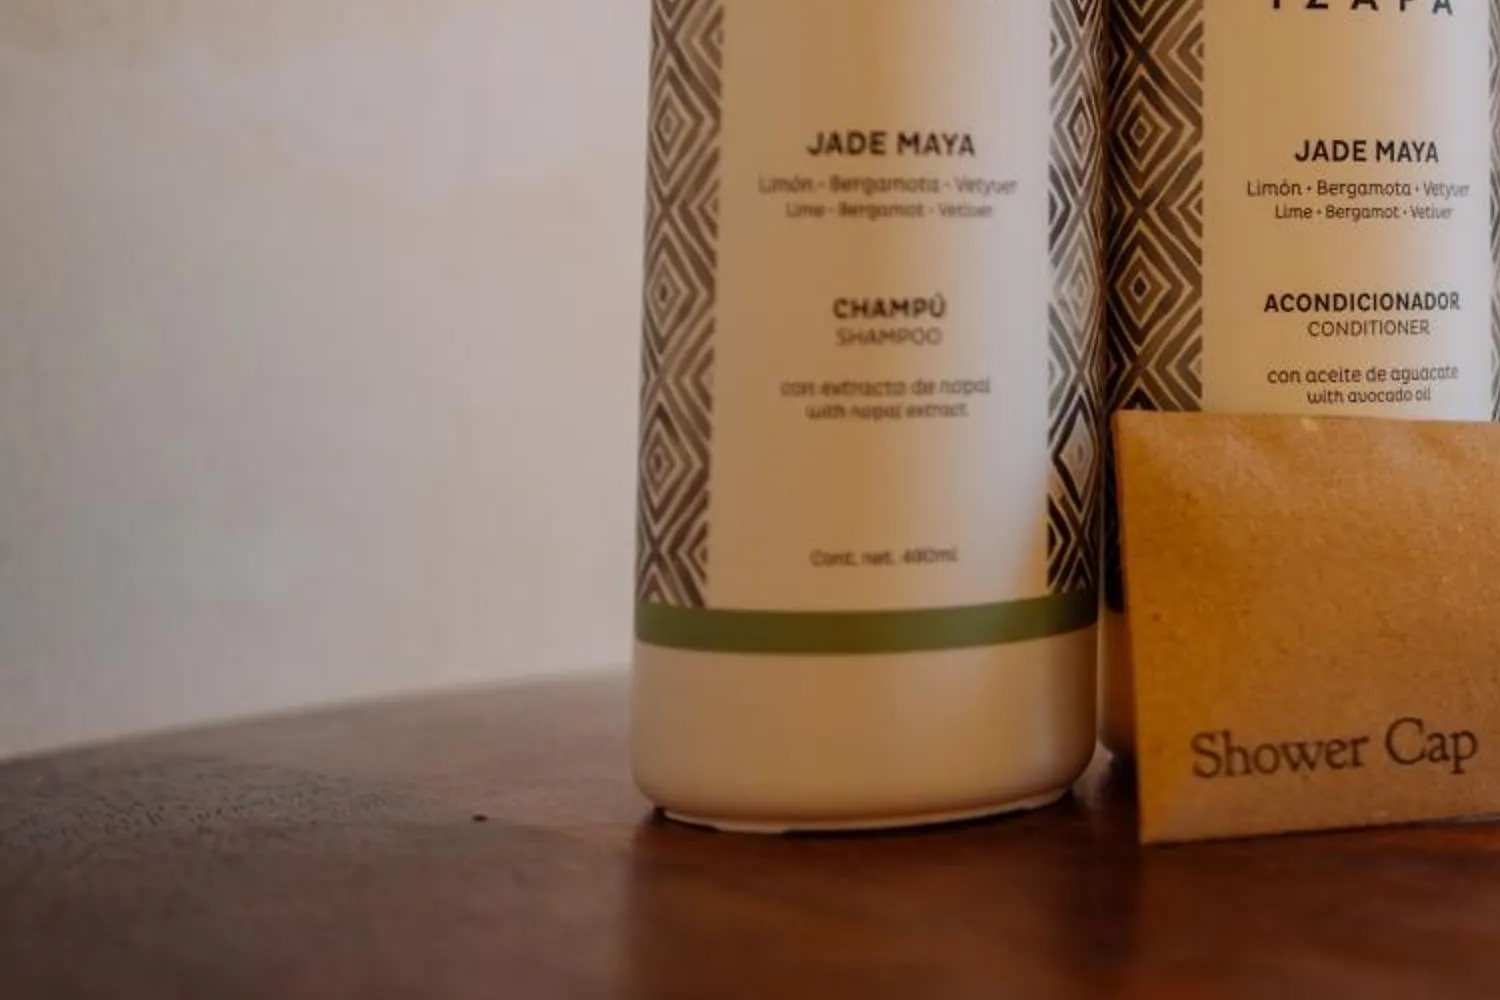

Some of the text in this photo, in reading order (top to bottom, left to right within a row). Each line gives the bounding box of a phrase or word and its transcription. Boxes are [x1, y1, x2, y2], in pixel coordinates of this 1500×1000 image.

[806, 130, 976, 158] JADE MAYA
[1294, 139, 1439, 164] JADE MAYA
[758, 174, 814, 195] Limón
[829, 174, 940, 196] Bergamota
[1246, 179, 1302, 197] Limón
[1316, 179, 1412, 199] Bergamota
[1274, 204, 1313, 219] Lime
[1325, 204, 1400, 223] Bergamot
[832, 292, 947, 320] CHAMPÚ
[1263, 291, 1461, 313] ACONDICIONADOR
[835, 327, 943, 347] SHAMPOO
[1307, 319, 1431, 338] CONDITIONER
[1267, 365, 1459, 385] con aceite de aguacate
[1307, 388, 1344, 405] with
[1415, 387, 1432, 402] oil
[1190, 716, 1479, 779] Shower Cap
